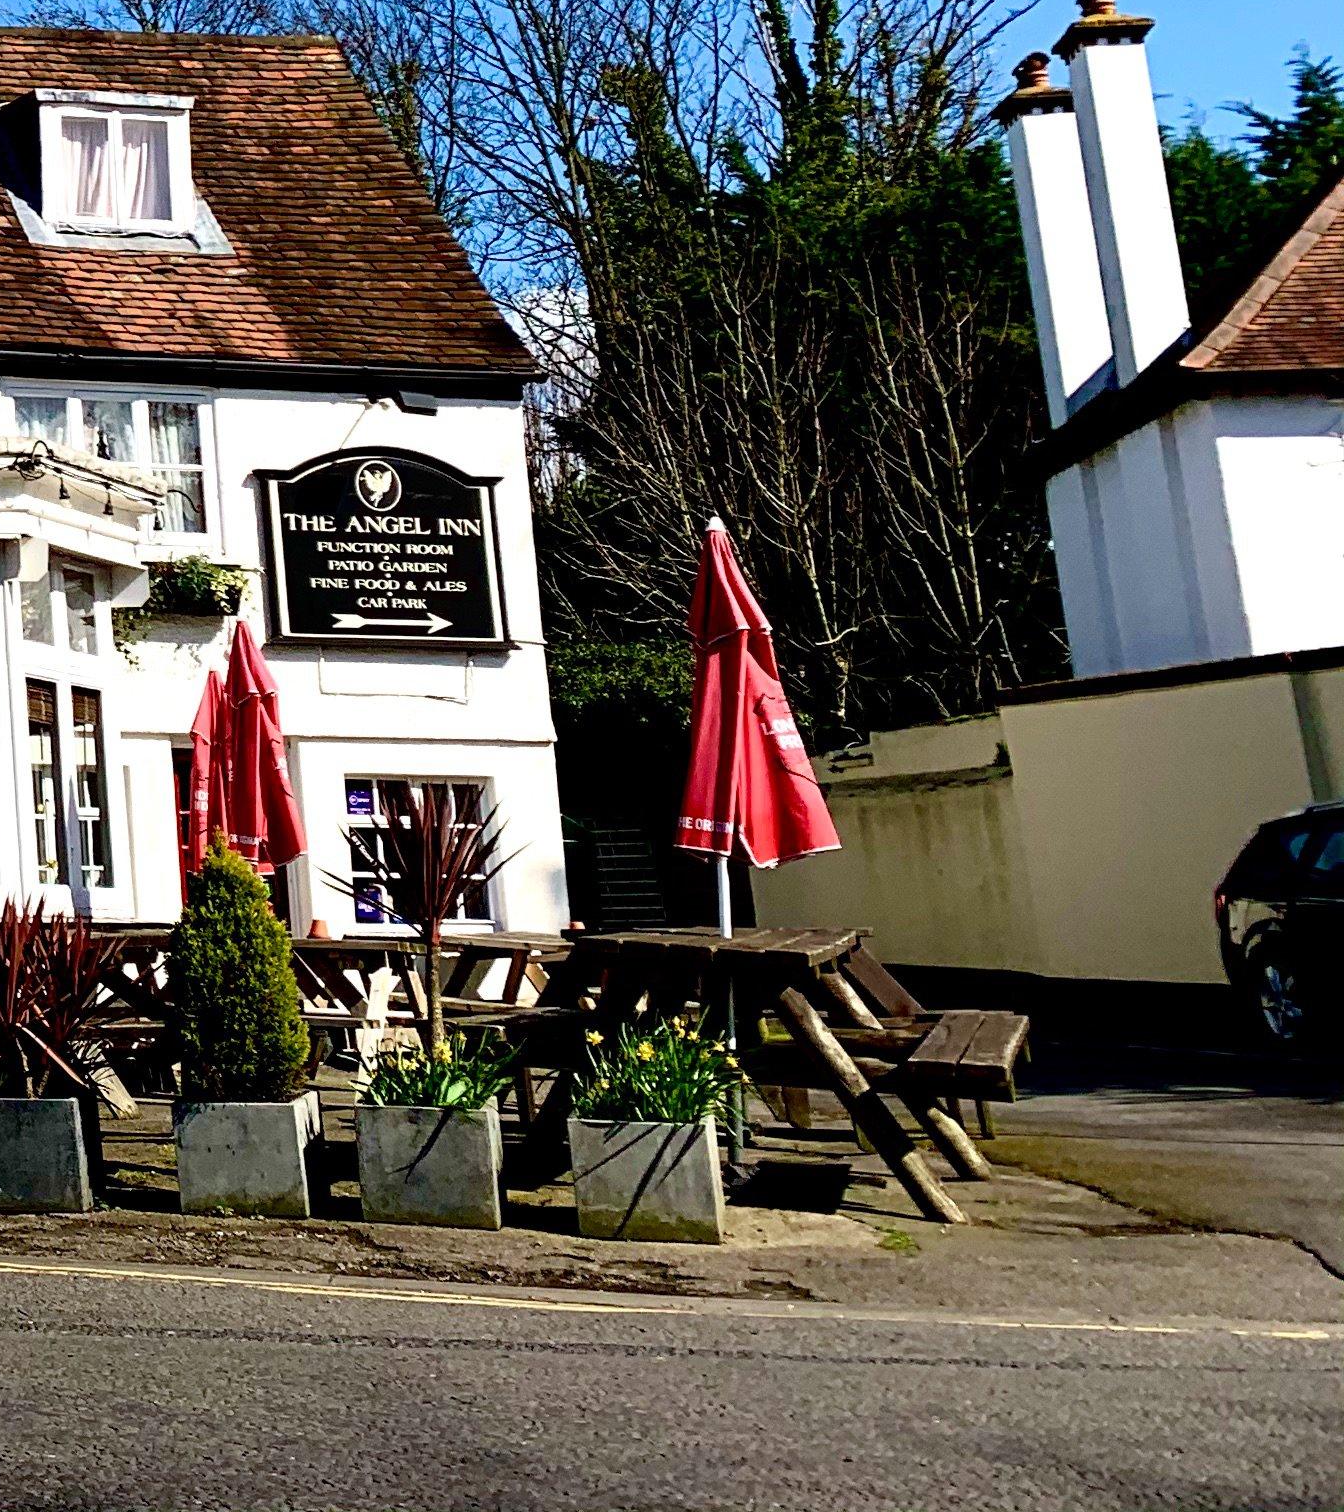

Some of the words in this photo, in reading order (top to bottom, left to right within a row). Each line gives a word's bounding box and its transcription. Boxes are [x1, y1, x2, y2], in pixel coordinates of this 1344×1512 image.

[283, 513, 336, 532] THE
[345, 516, 431, 534] ANGEL
[438, 518, 481, 536] INN
[317, 542, 400, 554] FUNCTION
[406, 544, 453, 555] ROOM
[328, 560, 374, 571] PATIO
[379, 561, 447, 572] GARDEN
[310, 578, 349, 589] FINE
[355, 579, 400, 590] FOOD
[405, 581, 417, 591] &
[423, 581, 467, 592] ALES
[357, 597, 388, 608] CAR
[392, 598, 427, 609] PARK
